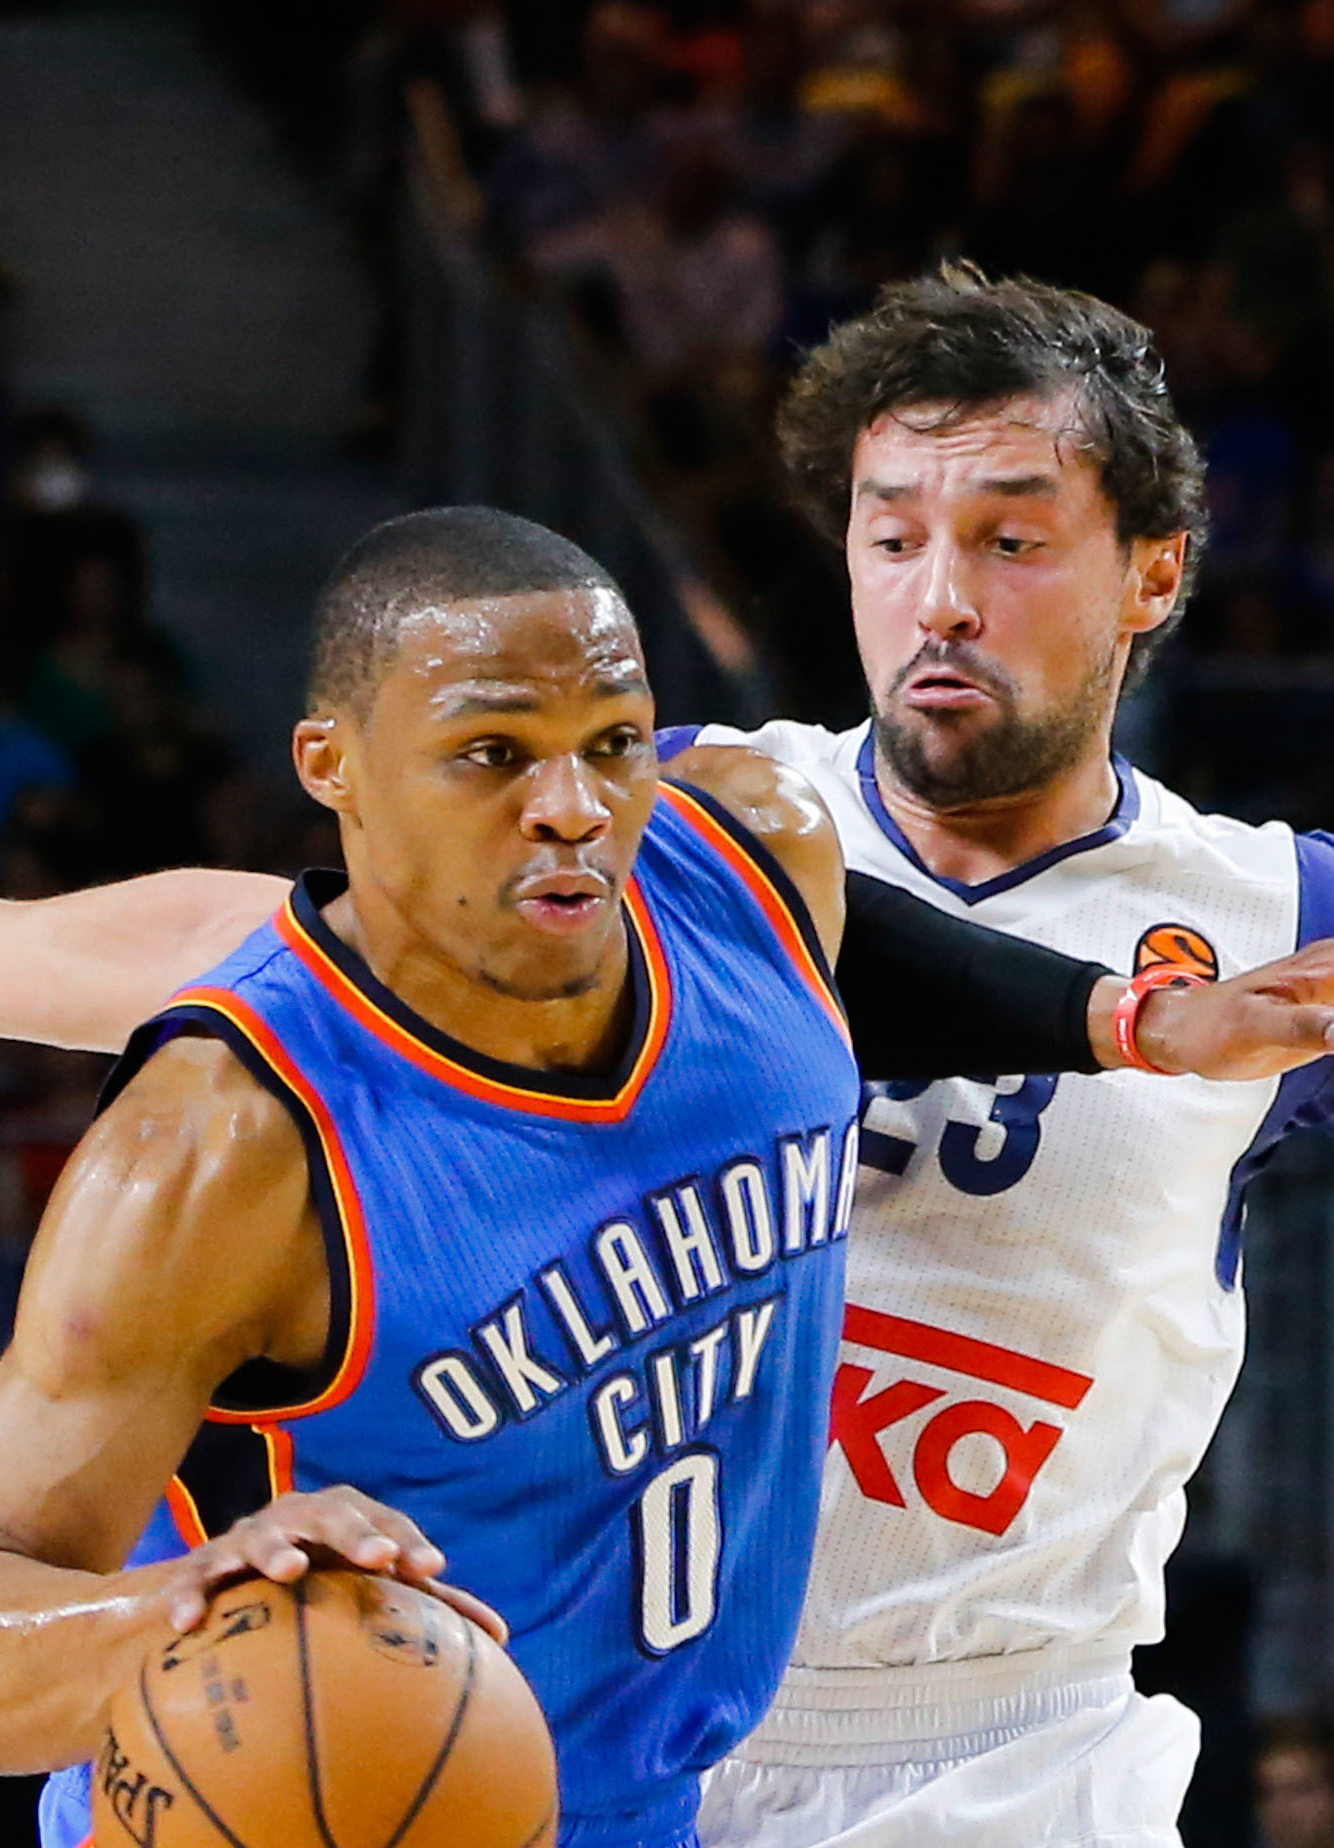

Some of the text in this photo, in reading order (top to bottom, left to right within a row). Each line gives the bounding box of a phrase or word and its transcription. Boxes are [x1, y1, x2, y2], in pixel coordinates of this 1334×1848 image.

[413, 1118, 860, 1442] OKLAHOMA
[591, 1296, 781, 1476] CITY
[635, 1449, 721, 1656] 0
